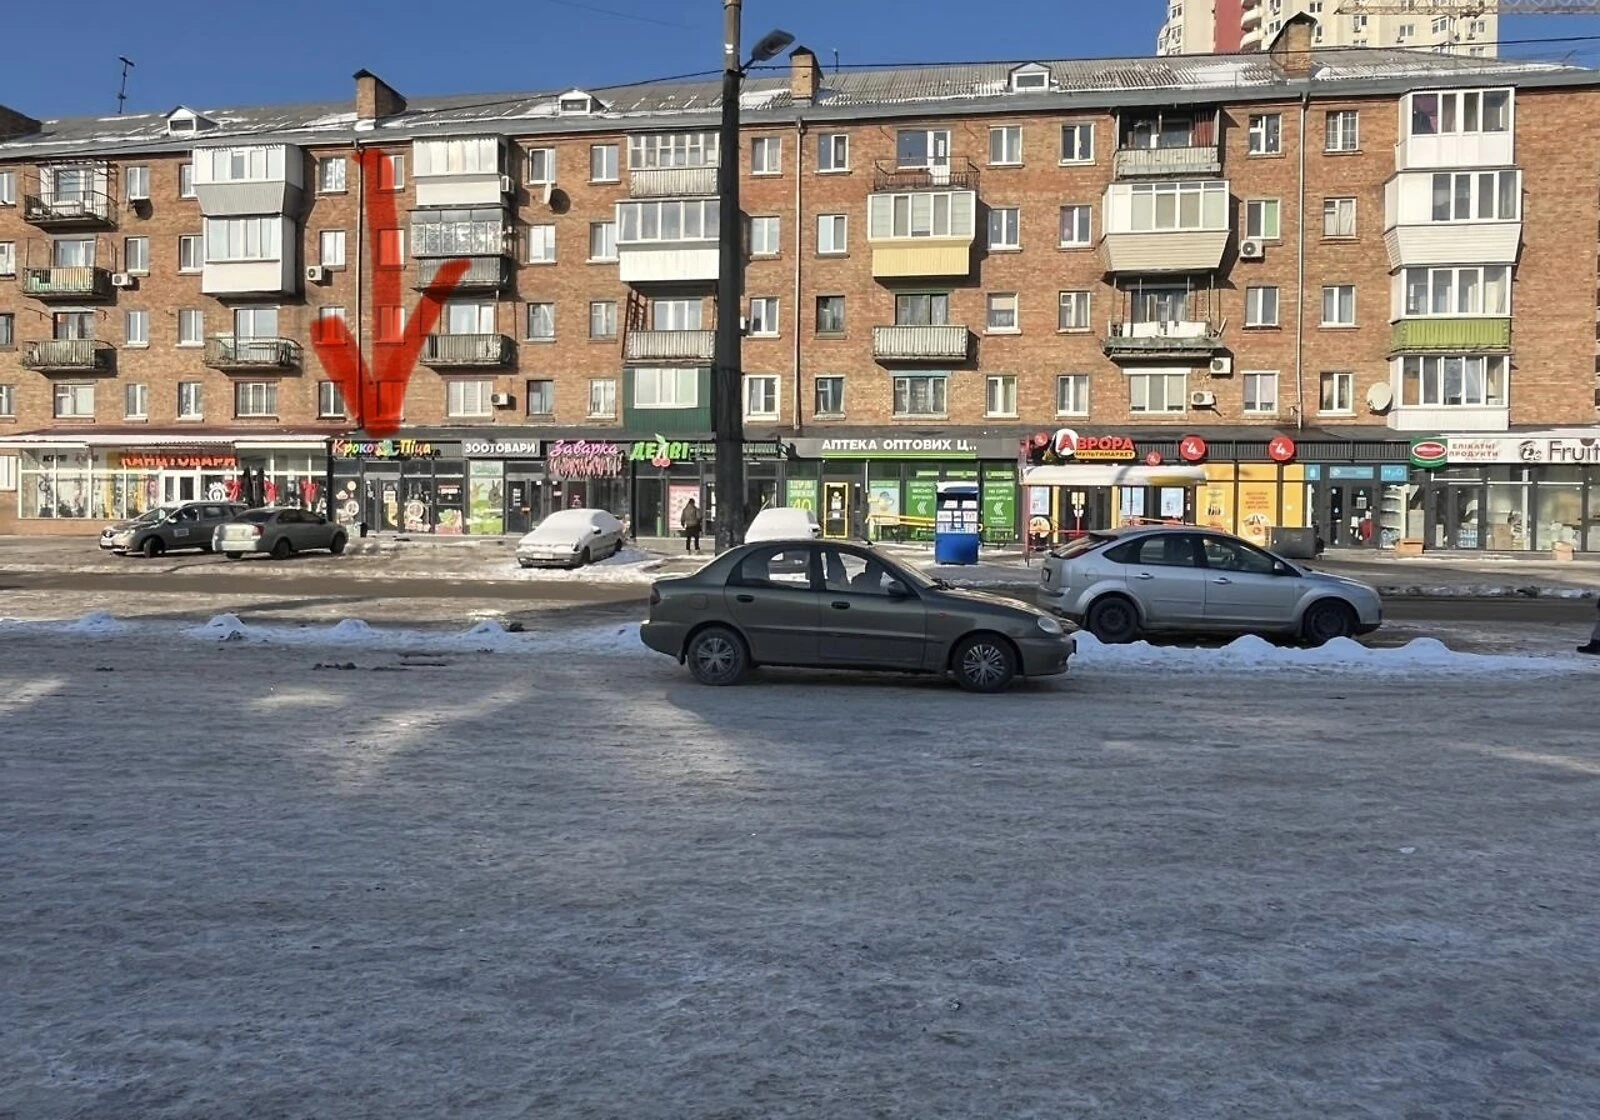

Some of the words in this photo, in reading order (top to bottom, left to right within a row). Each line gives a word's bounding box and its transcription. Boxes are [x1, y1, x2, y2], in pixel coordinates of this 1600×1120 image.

[332, 439, 374, 456] Кроко
[400, 439, 431, 455] Піца
[465, 443, 535, 453] ЗООТОВАРИ
[549, 440, 618, 457] Заварка
[822, 439, 877, 451] АПТЕКА
[883, 439, 951, 451] ОПТОВИХ
[1057, 433, 1134, 451] АВРОРА
